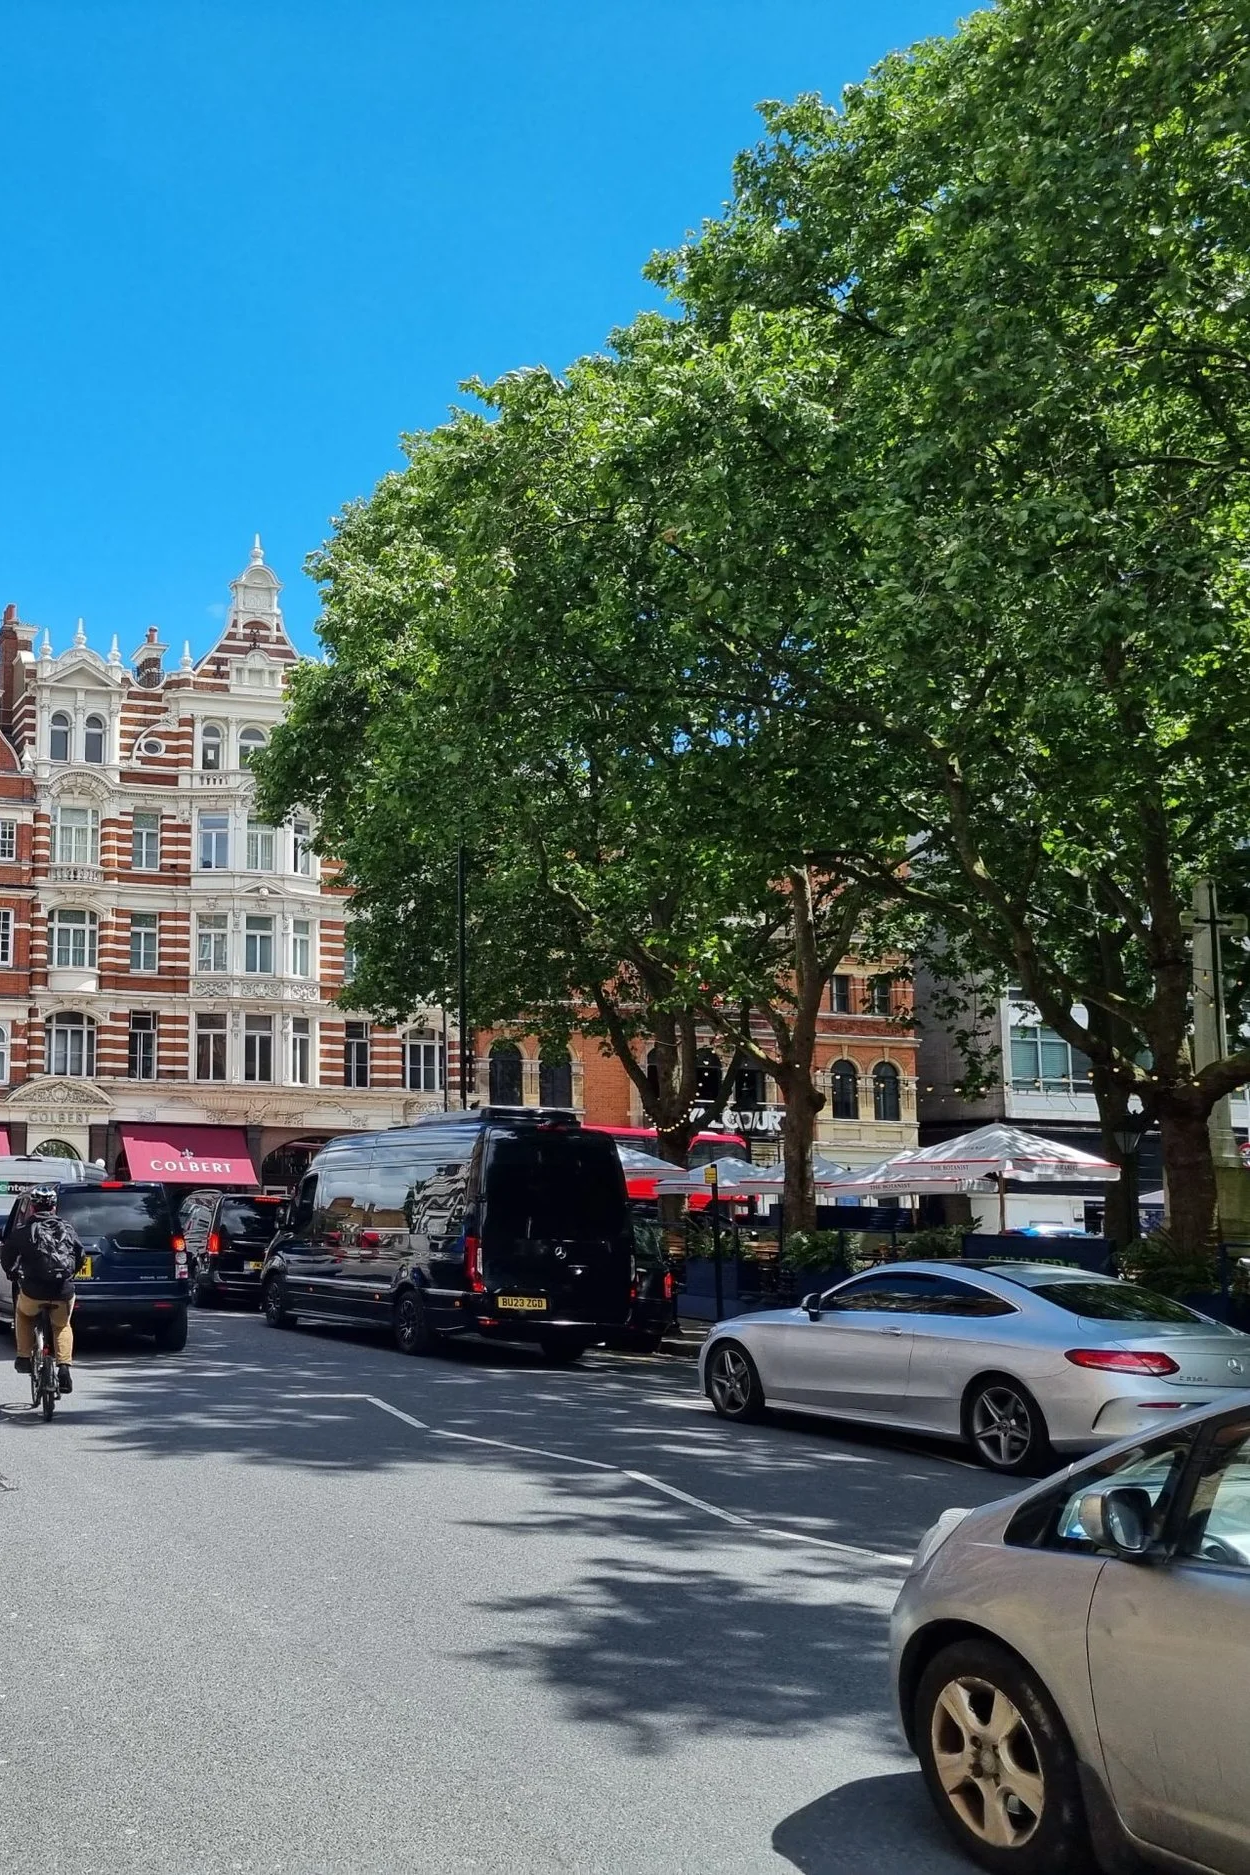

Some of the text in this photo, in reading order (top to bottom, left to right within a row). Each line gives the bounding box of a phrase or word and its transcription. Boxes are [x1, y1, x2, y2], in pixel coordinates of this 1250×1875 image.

[29, 1111, 91, 1123] COLBERT
[150, 1159, 231, 1173] COLBERT
[882, 1182, 911, 1190] BOTANIST
[502, 1297, 525, 1307] BU23
